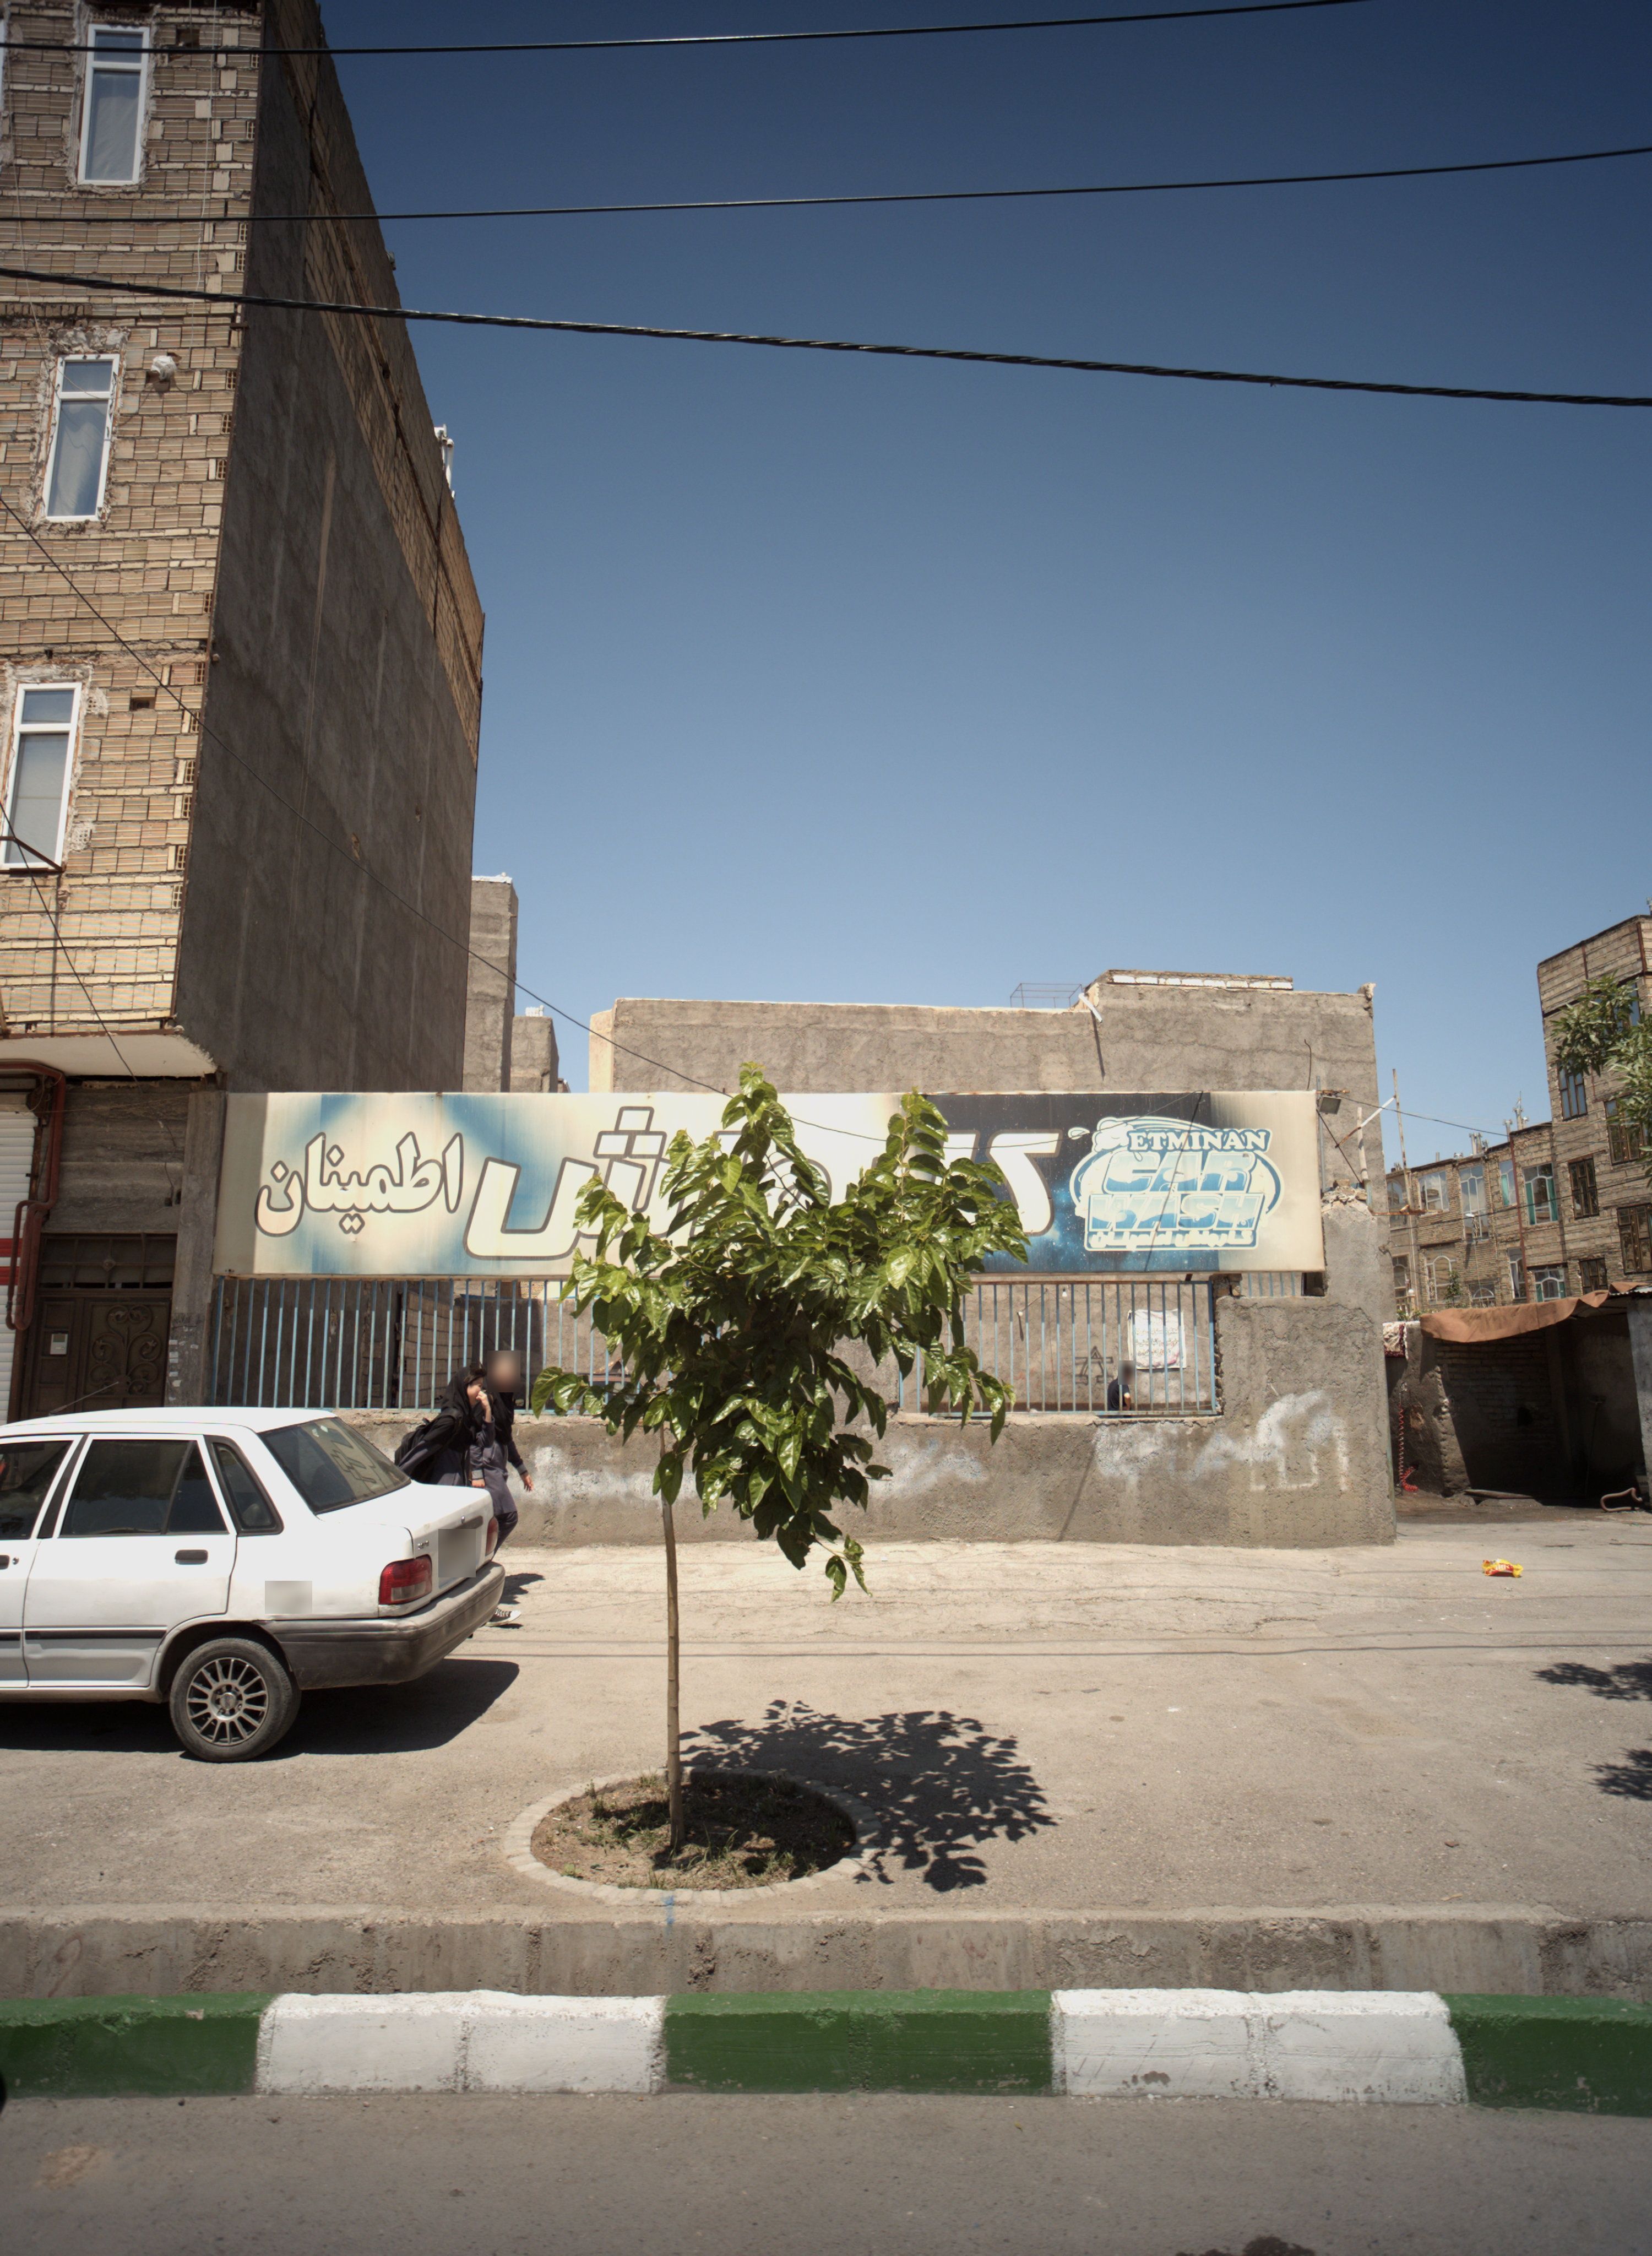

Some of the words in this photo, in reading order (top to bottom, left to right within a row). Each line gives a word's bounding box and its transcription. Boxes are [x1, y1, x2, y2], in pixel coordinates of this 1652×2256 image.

[1128, 1131, 1267, 1151] ETMINAN
[254, 1131, 464, 1238] اطمینان
[463, 1106, 1063, 1261] کاواش
[1103, 1151, 1256, 1194] CAR
[1089, 1193, 1265, 1232] WASH
